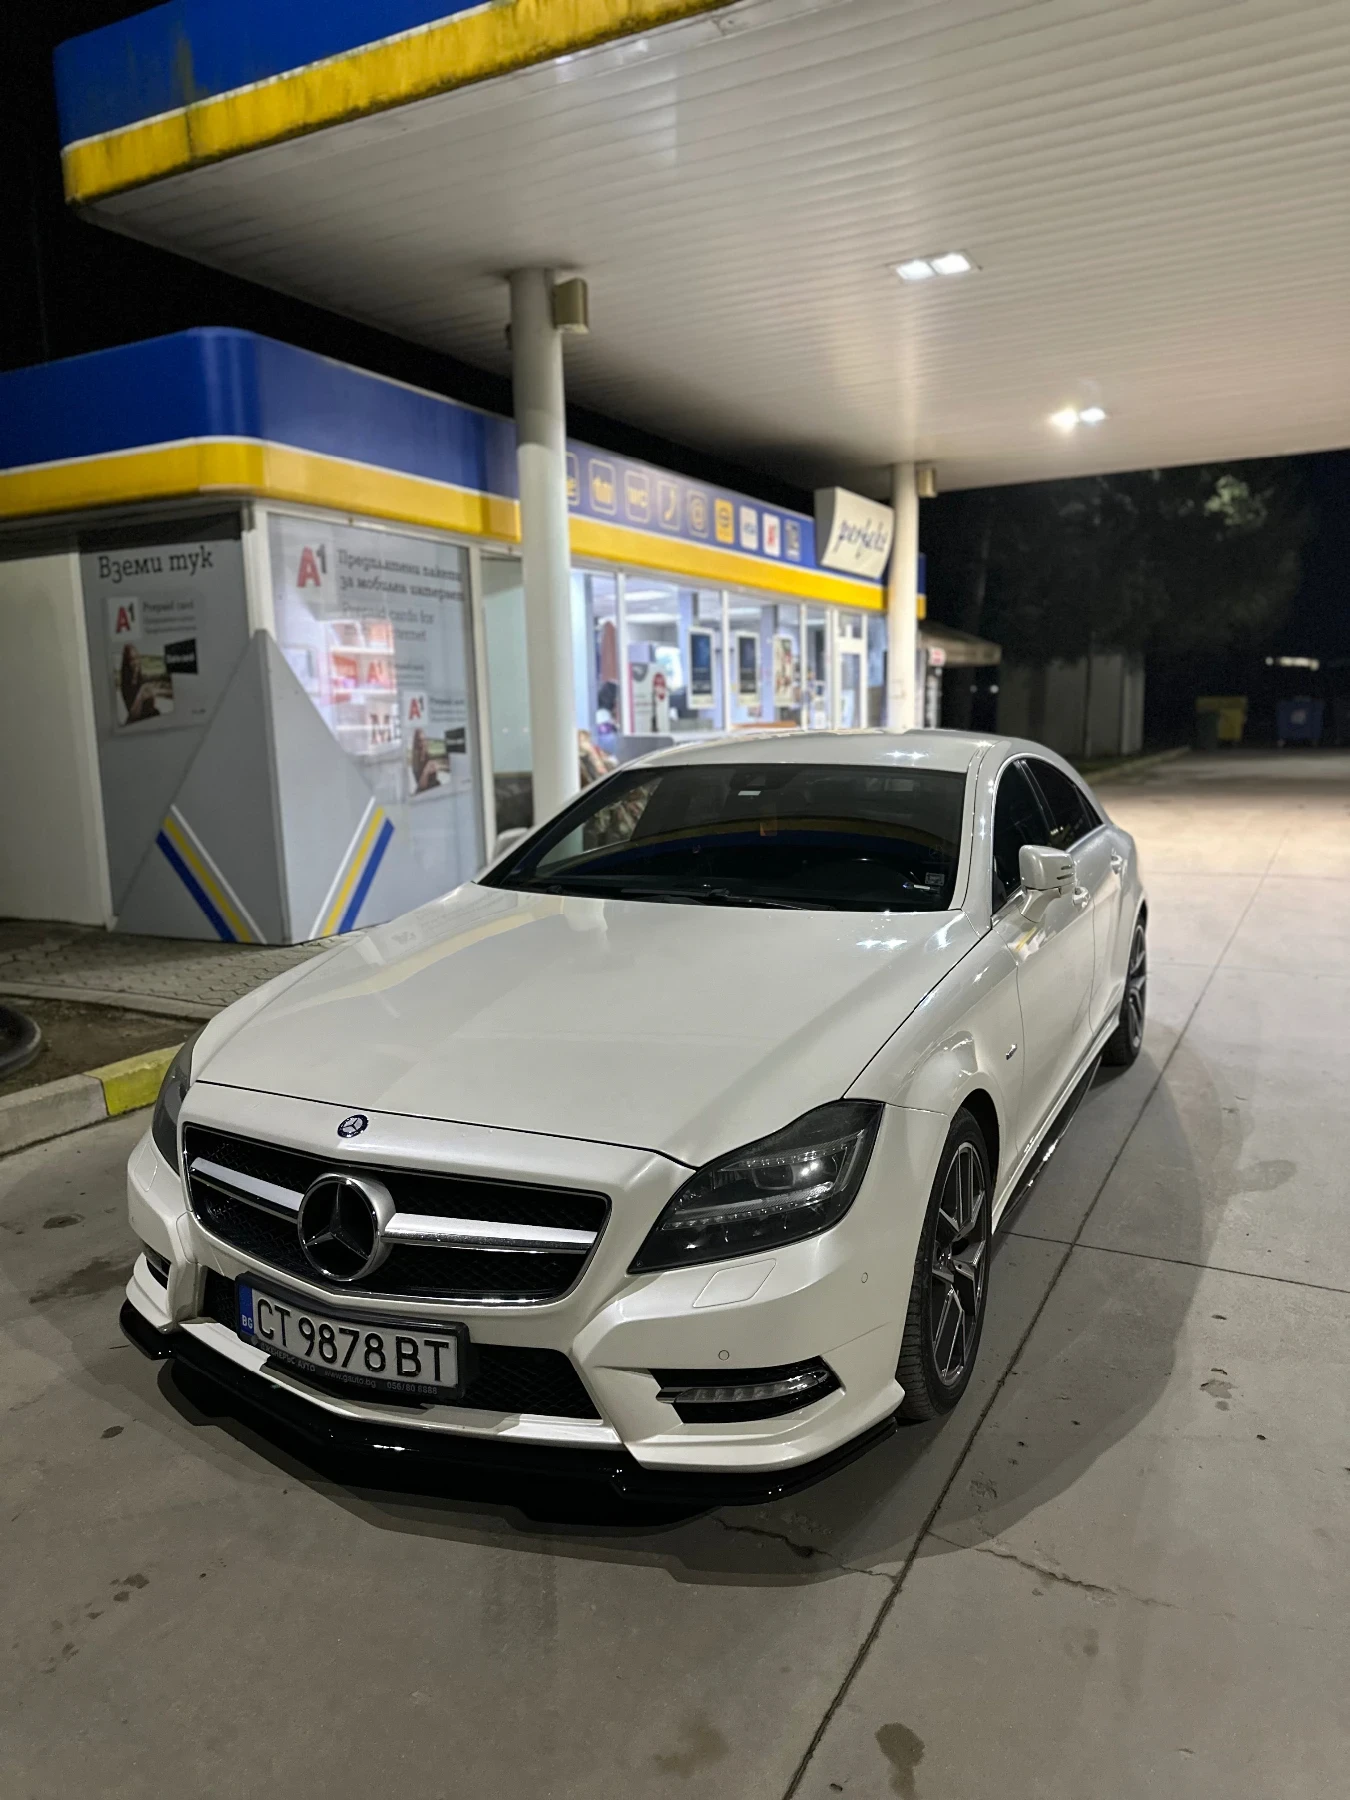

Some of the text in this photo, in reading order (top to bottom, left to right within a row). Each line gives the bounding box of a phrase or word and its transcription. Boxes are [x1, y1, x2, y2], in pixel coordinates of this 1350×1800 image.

[98, 544, 214, 584] Вземи тук
[296, 543, 327, 588] A1
[115, 602, 135, 634] A1
[408, 694, 425, 720] A1
[241, 1314, 253, 1329] BG
[257, 1298, 450, 1382] CT 9878 BT
[324, 1370, 377, 1389] www.gauto.bg
